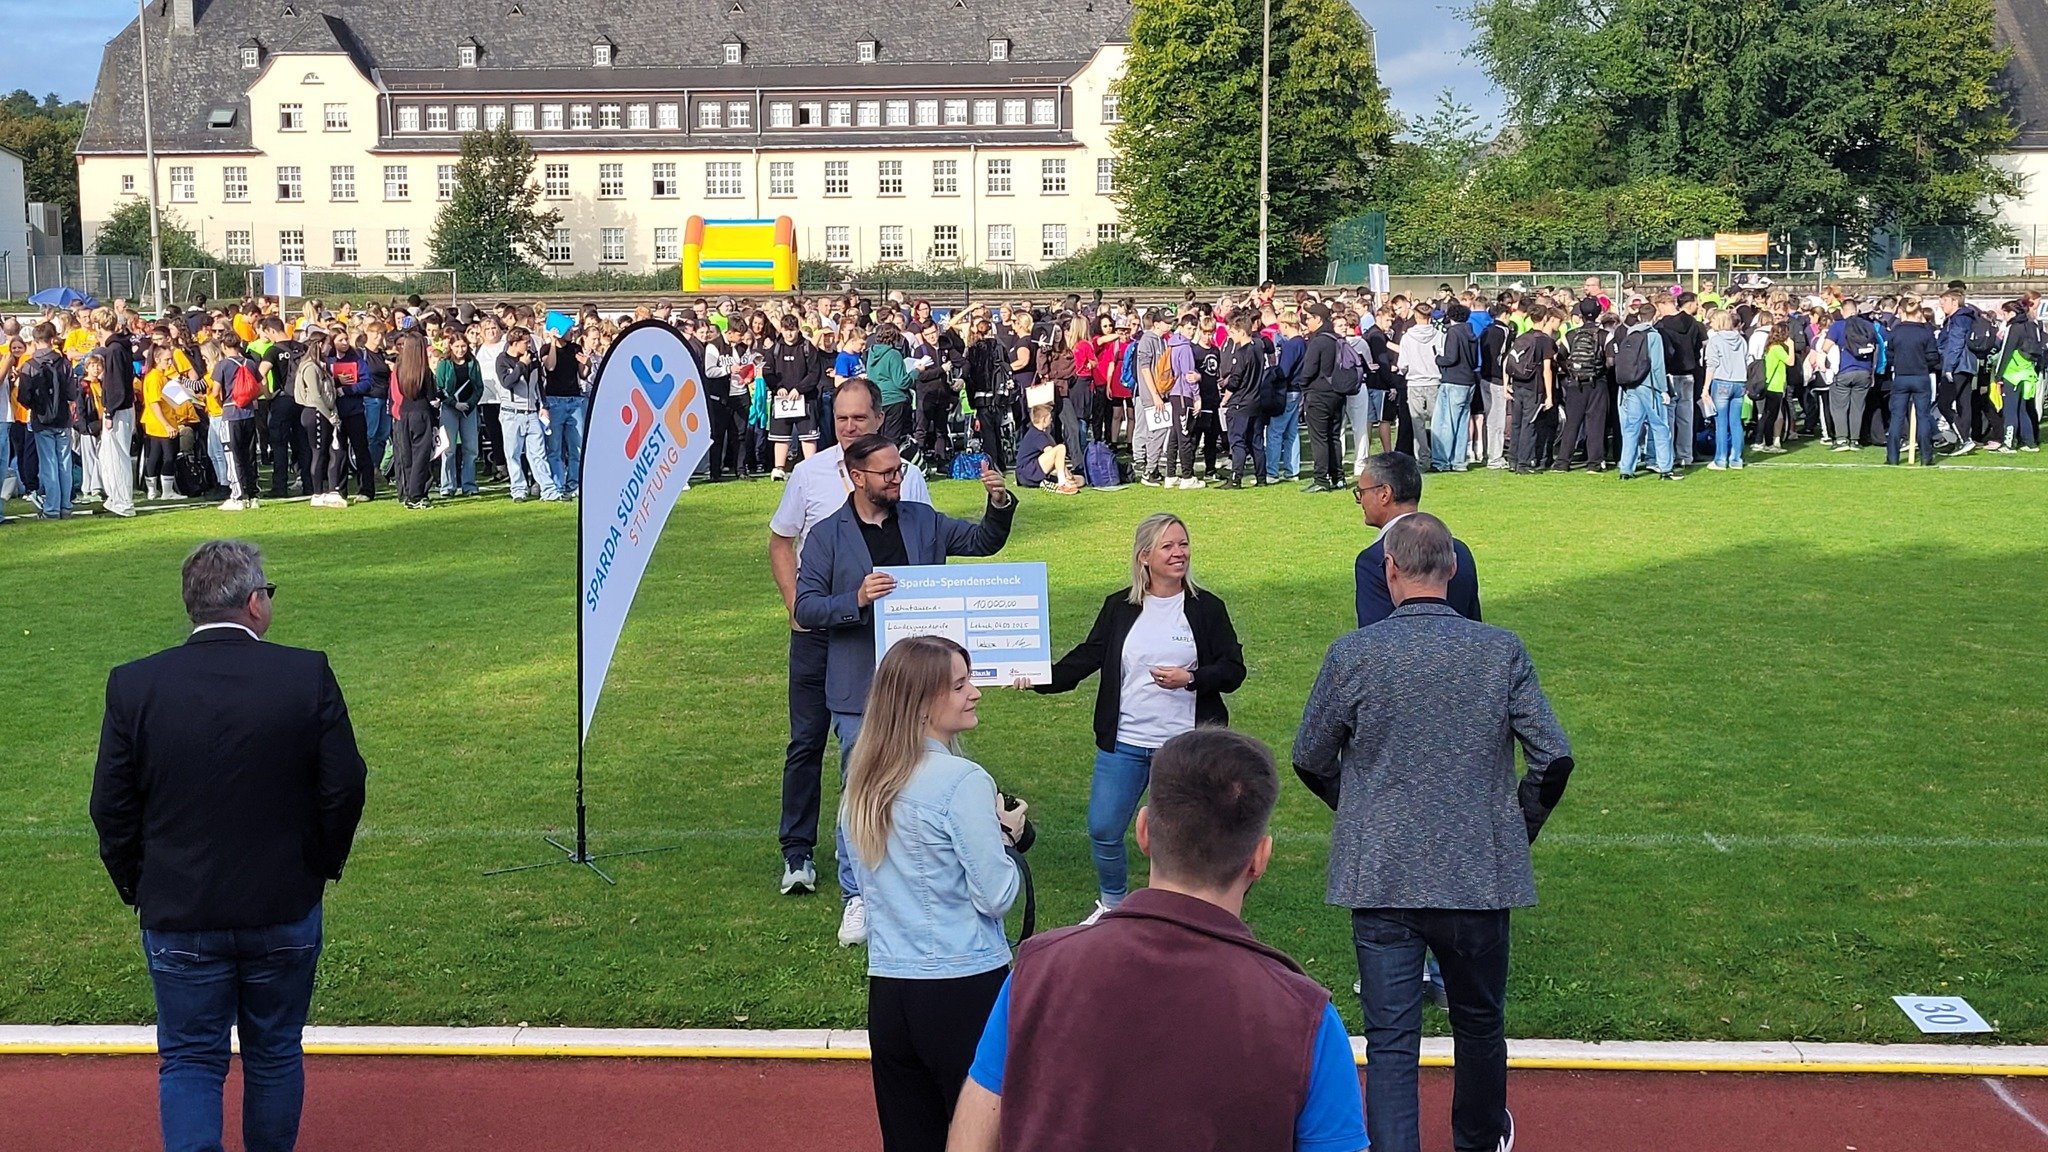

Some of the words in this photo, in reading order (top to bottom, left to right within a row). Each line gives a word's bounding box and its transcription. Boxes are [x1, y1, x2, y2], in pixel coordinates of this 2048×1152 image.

[1153, 410, 1170, 424] 80
[629, 446, 679, 547] STIFTUNG
[586, 525, 622, 612] SPARDA
[617, 423, 667, 527] SÜDWEST
[899, 575, 1022, 590] Sparda-Spendenscheck
[1914, 1002, 1969, 1025] 30
